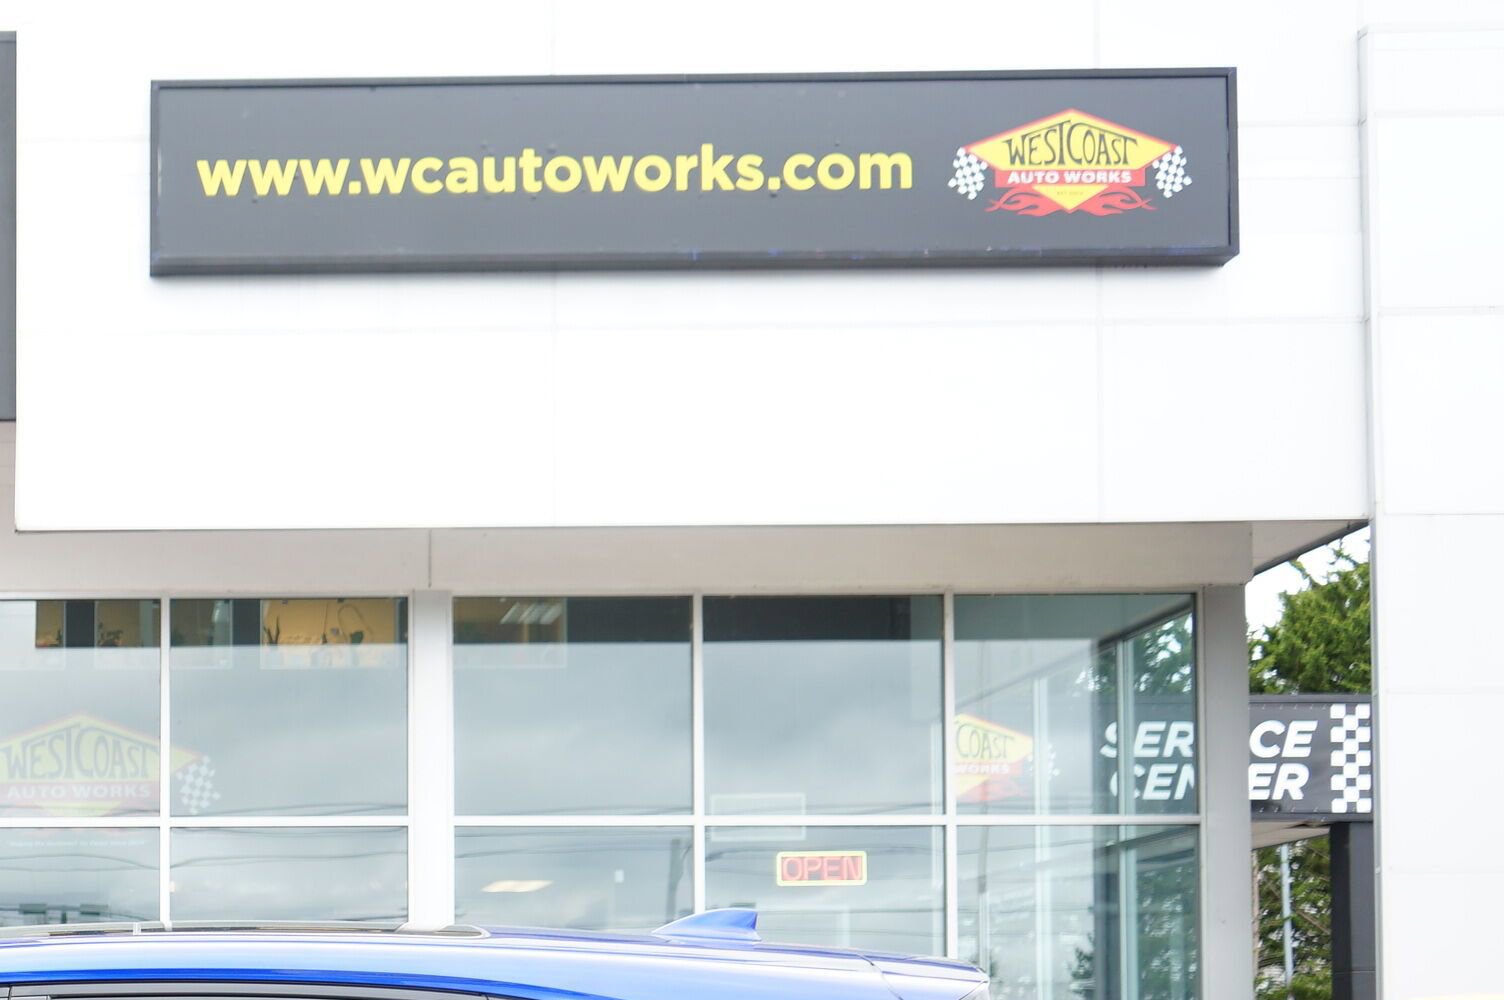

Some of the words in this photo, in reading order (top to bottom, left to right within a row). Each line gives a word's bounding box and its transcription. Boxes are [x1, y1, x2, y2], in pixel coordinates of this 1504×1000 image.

[197, 143, 913, 197] www.wcautoworks.com
[1007, 171, 1060, 184] AUTO
[1063, 170, 1133, 184] WORKS
[956, 723, 1015, 758] COAST
[1100, 720, 1318, 758] SERCE
[8, 784, 66, 798] AUTO
[71, 783, 152, 798] WORKS
[1109, 763, 1309, 800] CEER
[782, 856, 863, 881] OPEN
